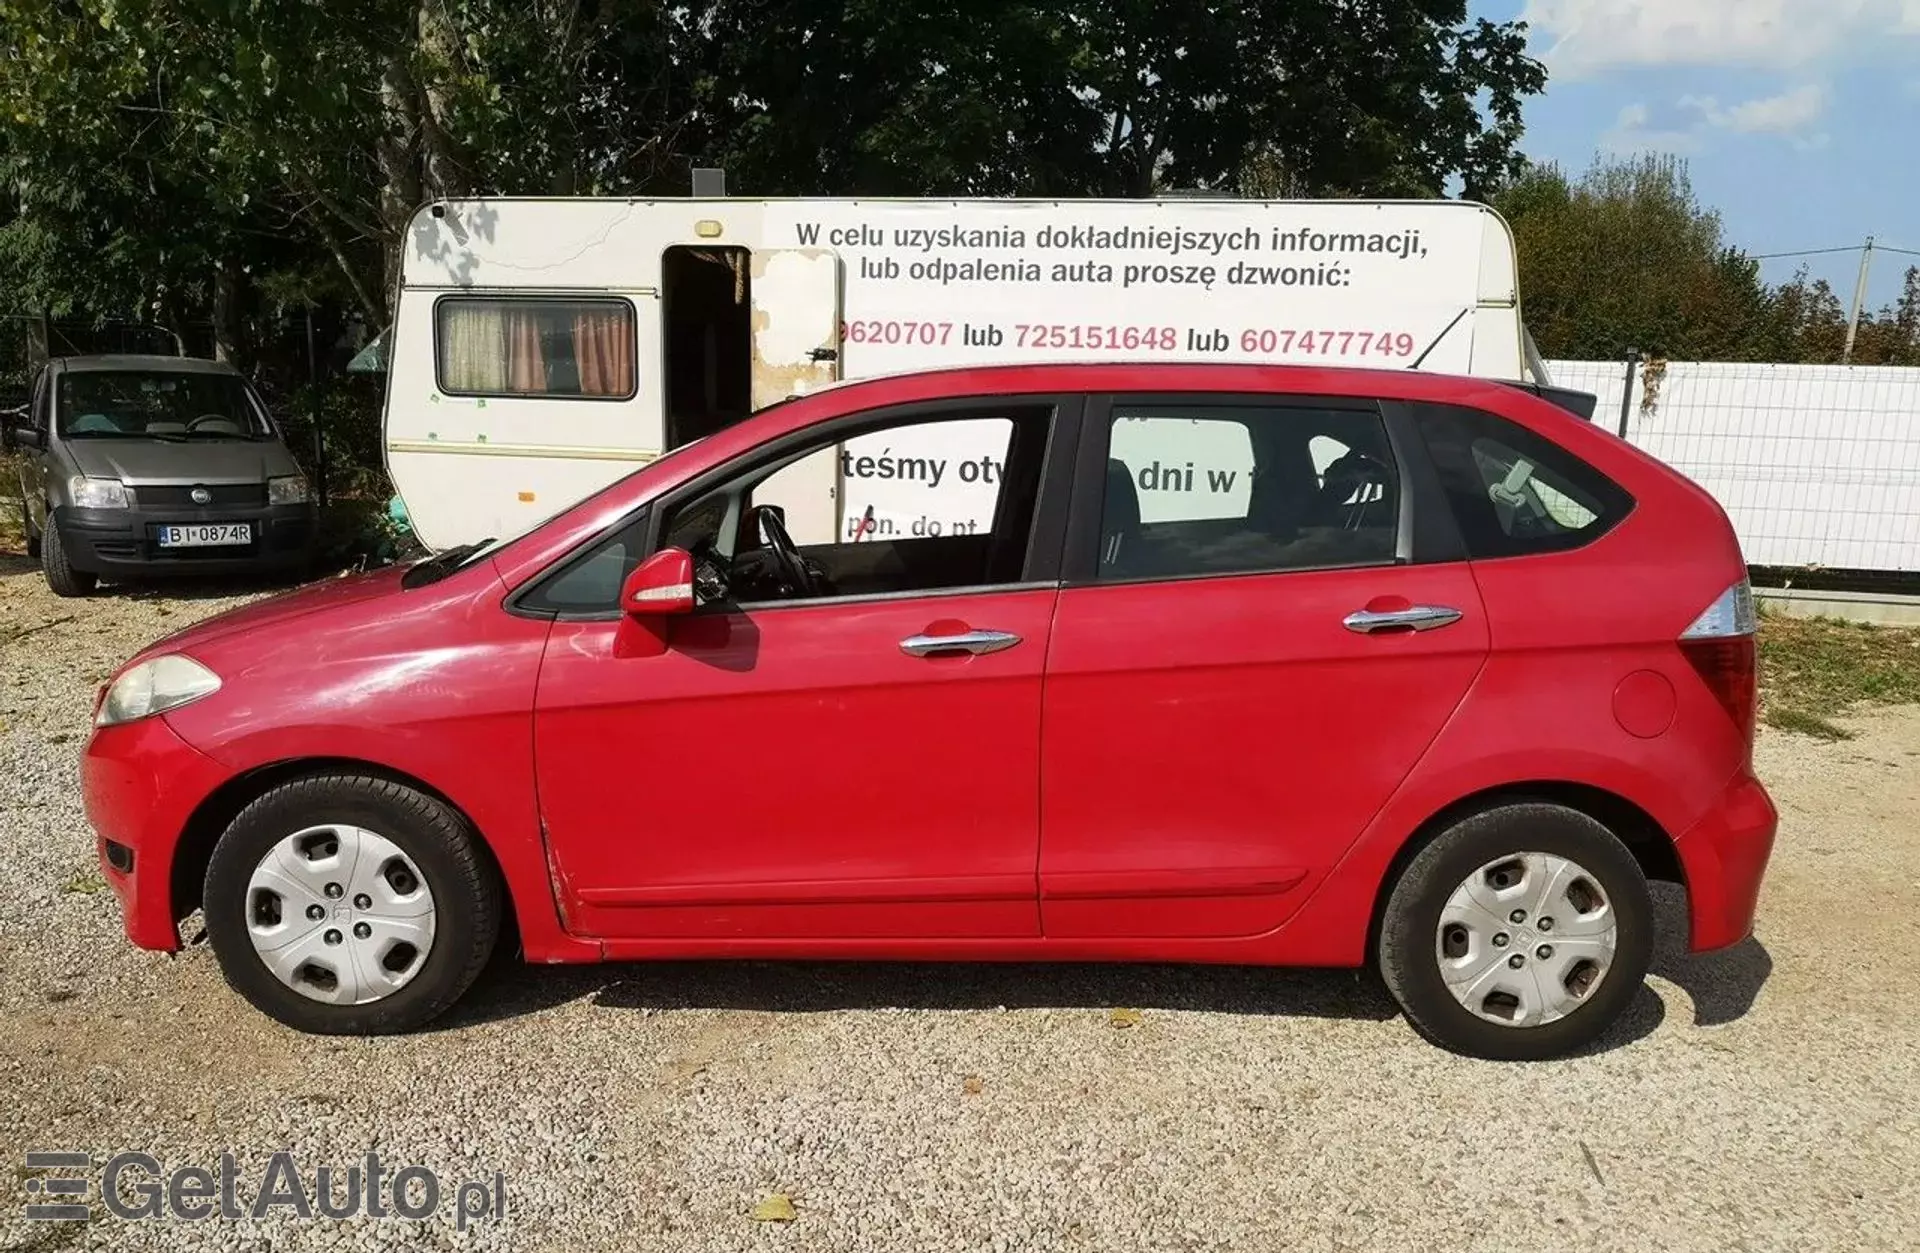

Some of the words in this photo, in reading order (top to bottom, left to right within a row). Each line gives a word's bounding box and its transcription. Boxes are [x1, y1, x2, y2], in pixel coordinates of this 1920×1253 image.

[795, 223, 821, 246] W
[829, 223, 884, 247] celu
[894, 224, 1026, 253] uzyskania
[1036, 224, 1261, 256] dokładniejszych
[1271, 226, 1428, 260] informacji,
[861, 256, 900, 280] lub
[909, 257, 1041, 286] odpalenia
[1051, 260, 1113, 283] auta
[1123, 265, 1217, 291] proszę
[1226, 260, 1351, 287] dzwonić:
[963, 323, 1004, 347] lub
[1015, 324, 1177, 351] 725151648
[1187, 328, 1230, 353] lub
[1240, 328, 1414, 357] 607477749
[1138, 461, 1194, 492] dni
[912, 516, 942, 537] do
